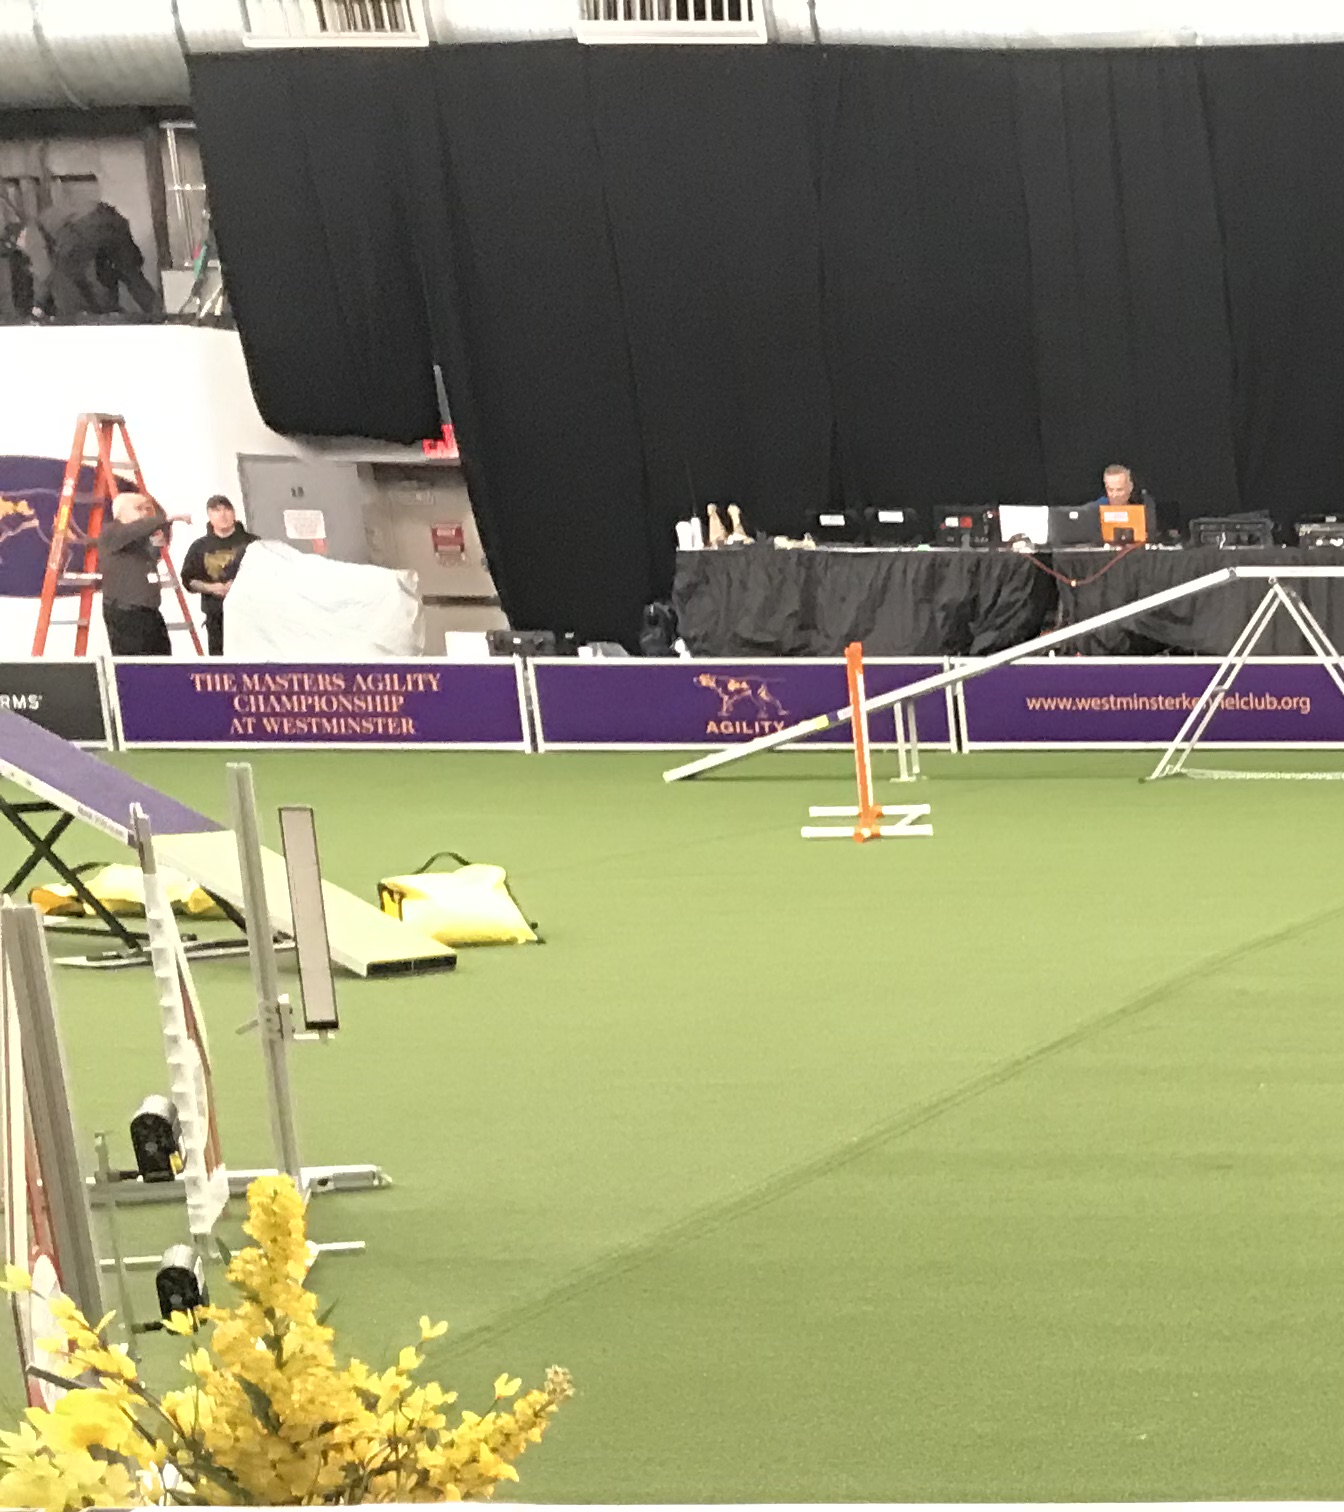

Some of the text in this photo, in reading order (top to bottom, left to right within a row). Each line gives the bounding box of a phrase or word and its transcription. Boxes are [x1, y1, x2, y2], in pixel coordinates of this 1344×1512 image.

[191, 673, 441, 692] THE MASTERS AGILITY
[233, 695, 404, 713] CHAMPIONSHIP
[1026, 692, 1310, 714] www.westminsterkenelclub.org
[230, 717, 416, 735] AT WESTMINSTER
[706, 720, 785, 734] AGILITY
